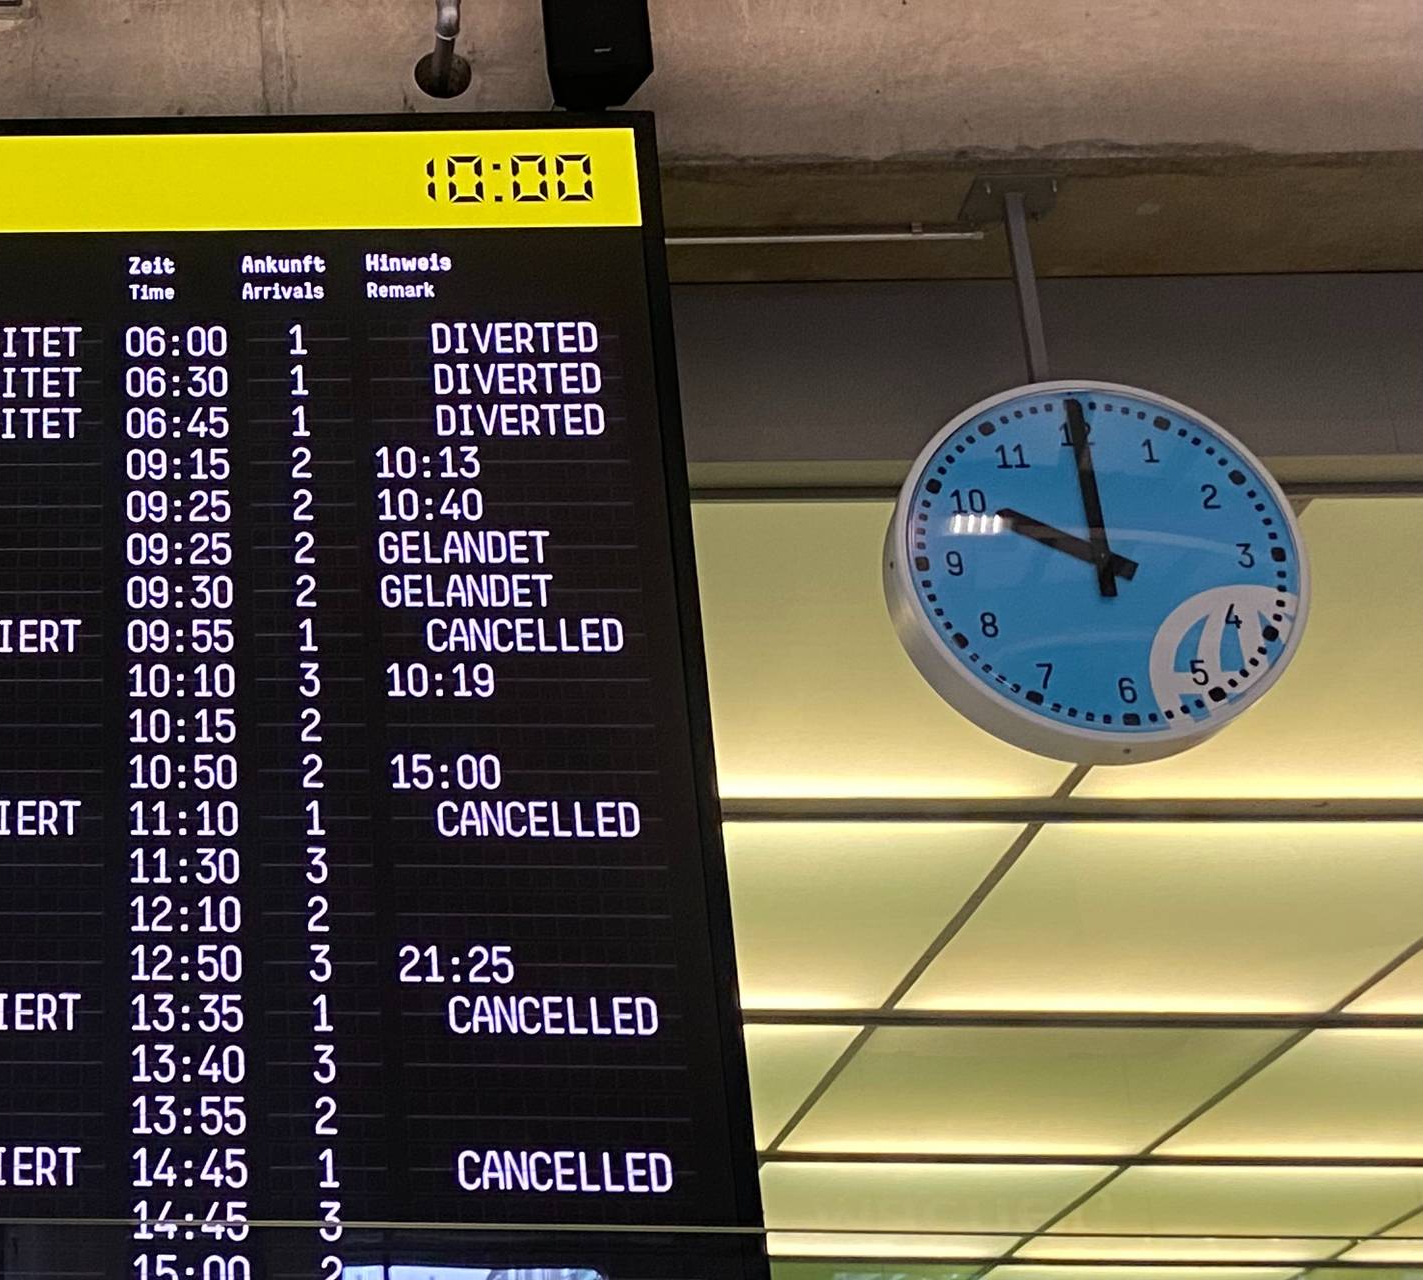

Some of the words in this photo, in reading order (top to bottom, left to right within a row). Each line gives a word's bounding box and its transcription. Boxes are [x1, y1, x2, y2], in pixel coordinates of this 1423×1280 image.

[425, 154, 594, 203] 10:00
[128, 256, 176, 275] Zeit
[241, 254, 327, 274] Ankunft
[365, 252, 452, 272] Hinweis
[128, 283, 175, 301] Time
[242, 281, 325, 300] Arrivals
[366, 280, 436, 299] Remark
[125, 325, 228, 358] 06:00
[288, 324, 308, 355] 1
[431, 322, 598, 354] DIVERTED
[125, 365, 228, 398] 06:30
[290, 364, 309, 396] 1
[433, 362, 602, 395] DIVERTED
[126, 406, 229, 439] 06:45
[291, 405, 311, 437] 1
[435, 403, 605, 436] DIVERTED
[126, 447, 230, 481] 09:15
[291, 446, 313, 479] 2
[375, 445, 481, 479] 10:13
[996, 444, 1031, 469] 11
[1142, 439, 1160, 463] 1
[126, 489, 231, 523] 09:25
[293, 488, 314, 521] 2
[377, 487, 483, 522] 10:40
[950, 489, 986, 515] 10
[1200, 484, 1221, 510] 2
[126, 532, 232, 566] 09:25
[294, 531, 316, 564] 2
[378, 530, 550, 565] GELANDET
[946, 551, 964, 577] 9
[1236, 543, 1255, 569] 3
[126, 575, 234, 609] 09:30
[296, 574, 317, 608] 2
[380, 573, 554, 608] GELANDET
[980, 611, 999, 638] 8
[1224, 603, 1243, 629] 4
[127, 618, 234, 654] 09:55
[298, 618, 319, 652] 1
[426, 617, 624, 653] CANCELLED
[128, 663, 236, 698] 10:10
[299, 662, 321, 698] 3
[386, 662, 495, 698] 10:19
[1036, 663, 1054, 690] 7
[1118, 677, 1138, 704] 6
[1189, 659, 1210, 686] 5
[129, 708, 236, 744] 10:15
[300, 707, 323, 742] 2
[129, 754, 238, 790] 10:50
[302, 753, 325, 789] 2
[390, 753, 501, 790] 15:00
[129, 800, 239, 837] 11:10
[305, 799, 326, 836] 1
[436, 800, 641, 838] CANCELLED
[130, 847, 240, 885] 11:30
[305, 847, 328, 884] 3
[130, 895, 241, 933] 12:10
[307, 895, 330, 932] 2
[130, 944, 243, 983] 12:50
[309, 944, 332, 983] 3
[399, 945, 515, 984] 21:25
[131, 993, 244, 1033] 13:35
[312, 993, 334, 1032] 1
[448, 995, 659, 1036] CANCELLED
[131, 1044, 246, 1084] 13:40
[313, 1044, 336, 1084] 3
[132, 1095, 247, 1136] 13:55
[315, 1096, 338, 1135] 2
[132, 1147, 248, 1189] 14:45
[318, 1148, 340, 1188] 1
[457, 1150, 673, 1193] CANCELLED
[132, 1200, 250, 1241] 14:45
